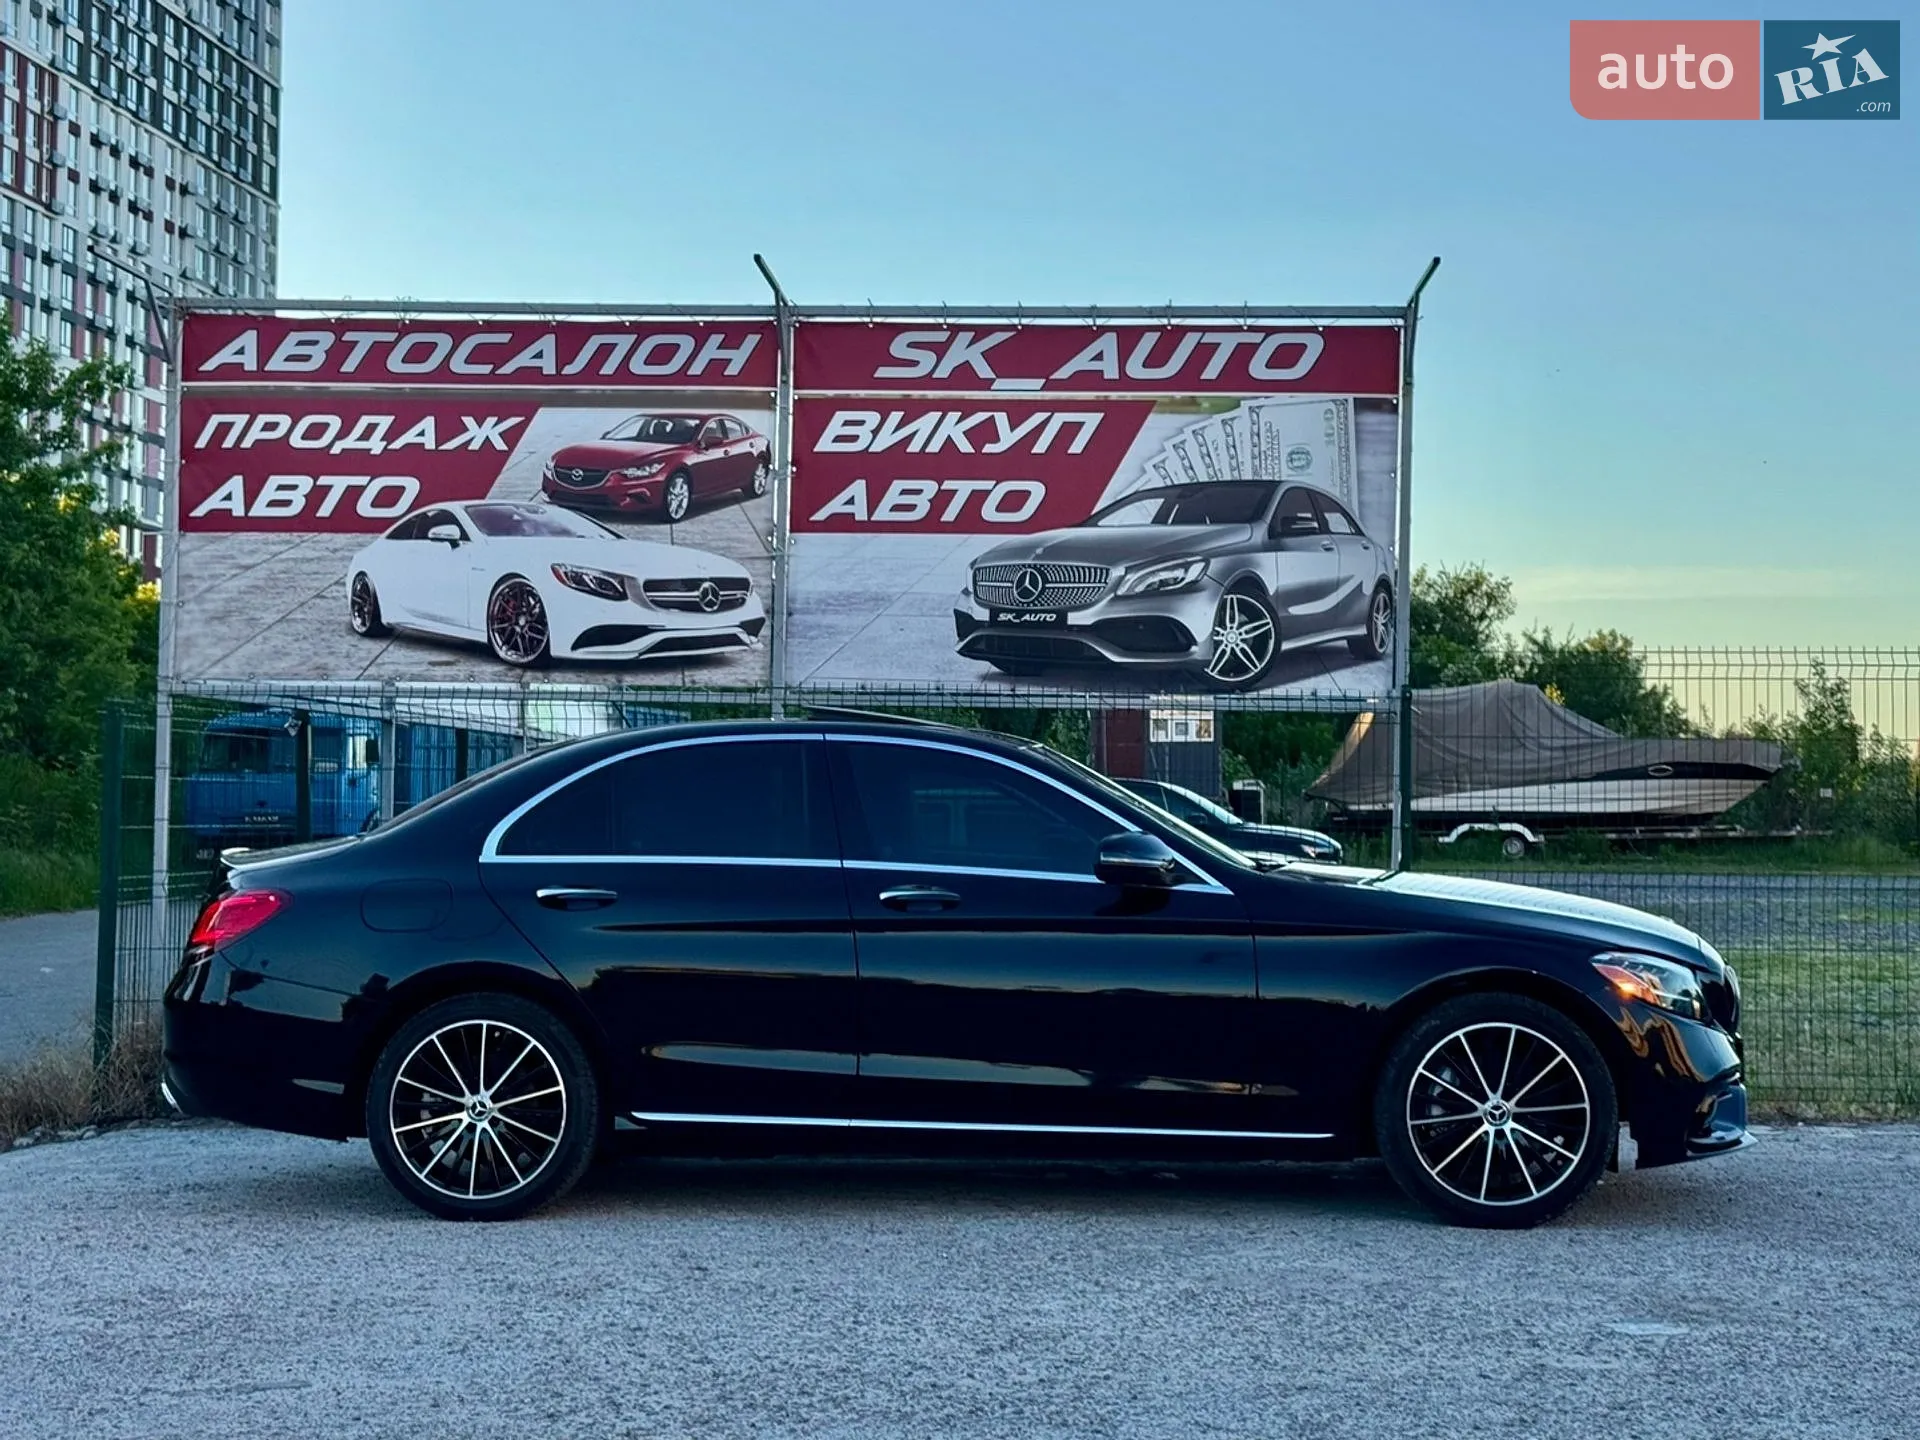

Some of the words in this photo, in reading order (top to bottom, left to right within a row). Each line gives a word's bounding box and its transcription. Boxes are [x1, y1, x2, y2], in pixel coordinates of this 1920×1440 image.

[199, 329, 763, 376] АВТОСАЛОН
[873, 330, 1326, 391] SK_AUTO
[194, 413, 526, 456] ПРОДАЖ
[812, 410, 1106, 455] ВИКУП
[189, 474, 421, 518] АВТО
[808, 479, 1047, 522] АВТО
[997, 612, 1057, 623] SK_AUTO
